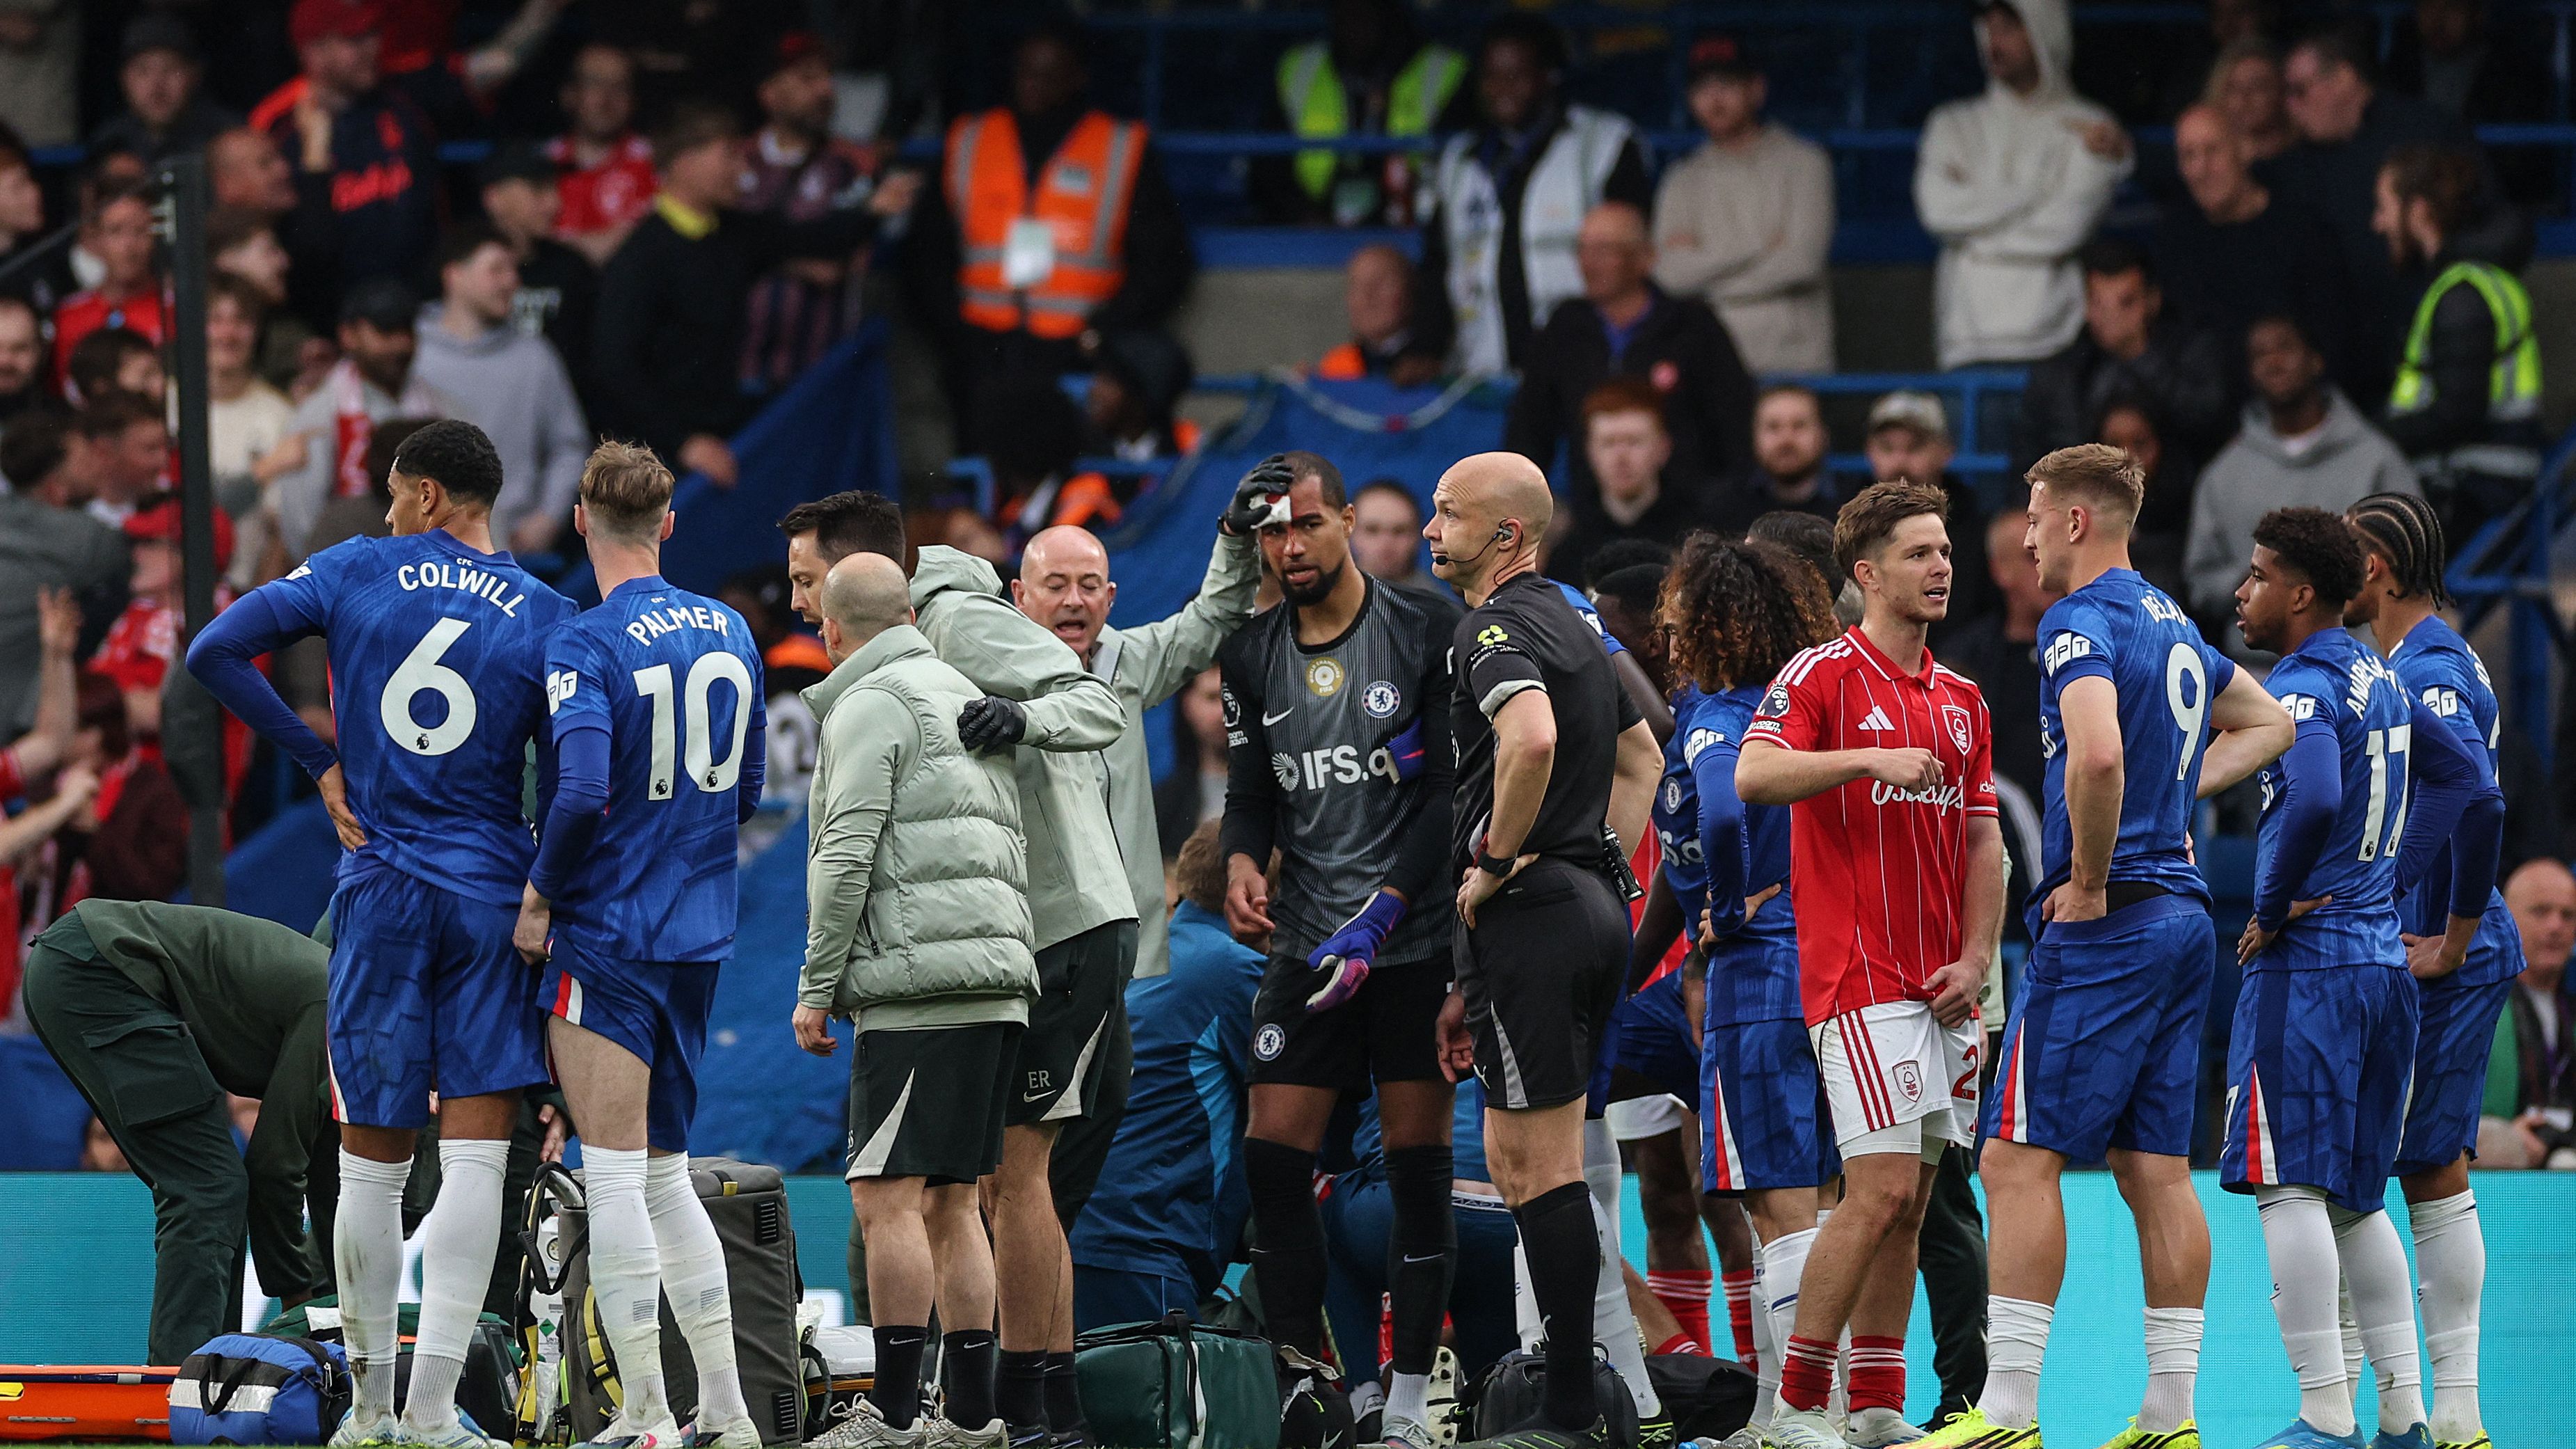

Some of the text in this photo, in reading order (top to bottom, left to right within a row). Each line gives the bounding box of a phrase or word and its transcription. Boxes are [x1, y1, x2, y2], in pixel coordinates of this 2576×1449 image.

[398, 562, 525, 618] COLWILL
[456, 557, 472, 567] CFC
[626, 606, 728, 647] PALMER
[381, 617, 477, 756] 6
[2166, 642, 2207, 781] 9
[633, 651, 753, 801] 10
[1302, 745, 1390, 791] IFS.a
[2358, 723, 2411, 862] 17
[1028, 1070, 1051, 1089] ER
